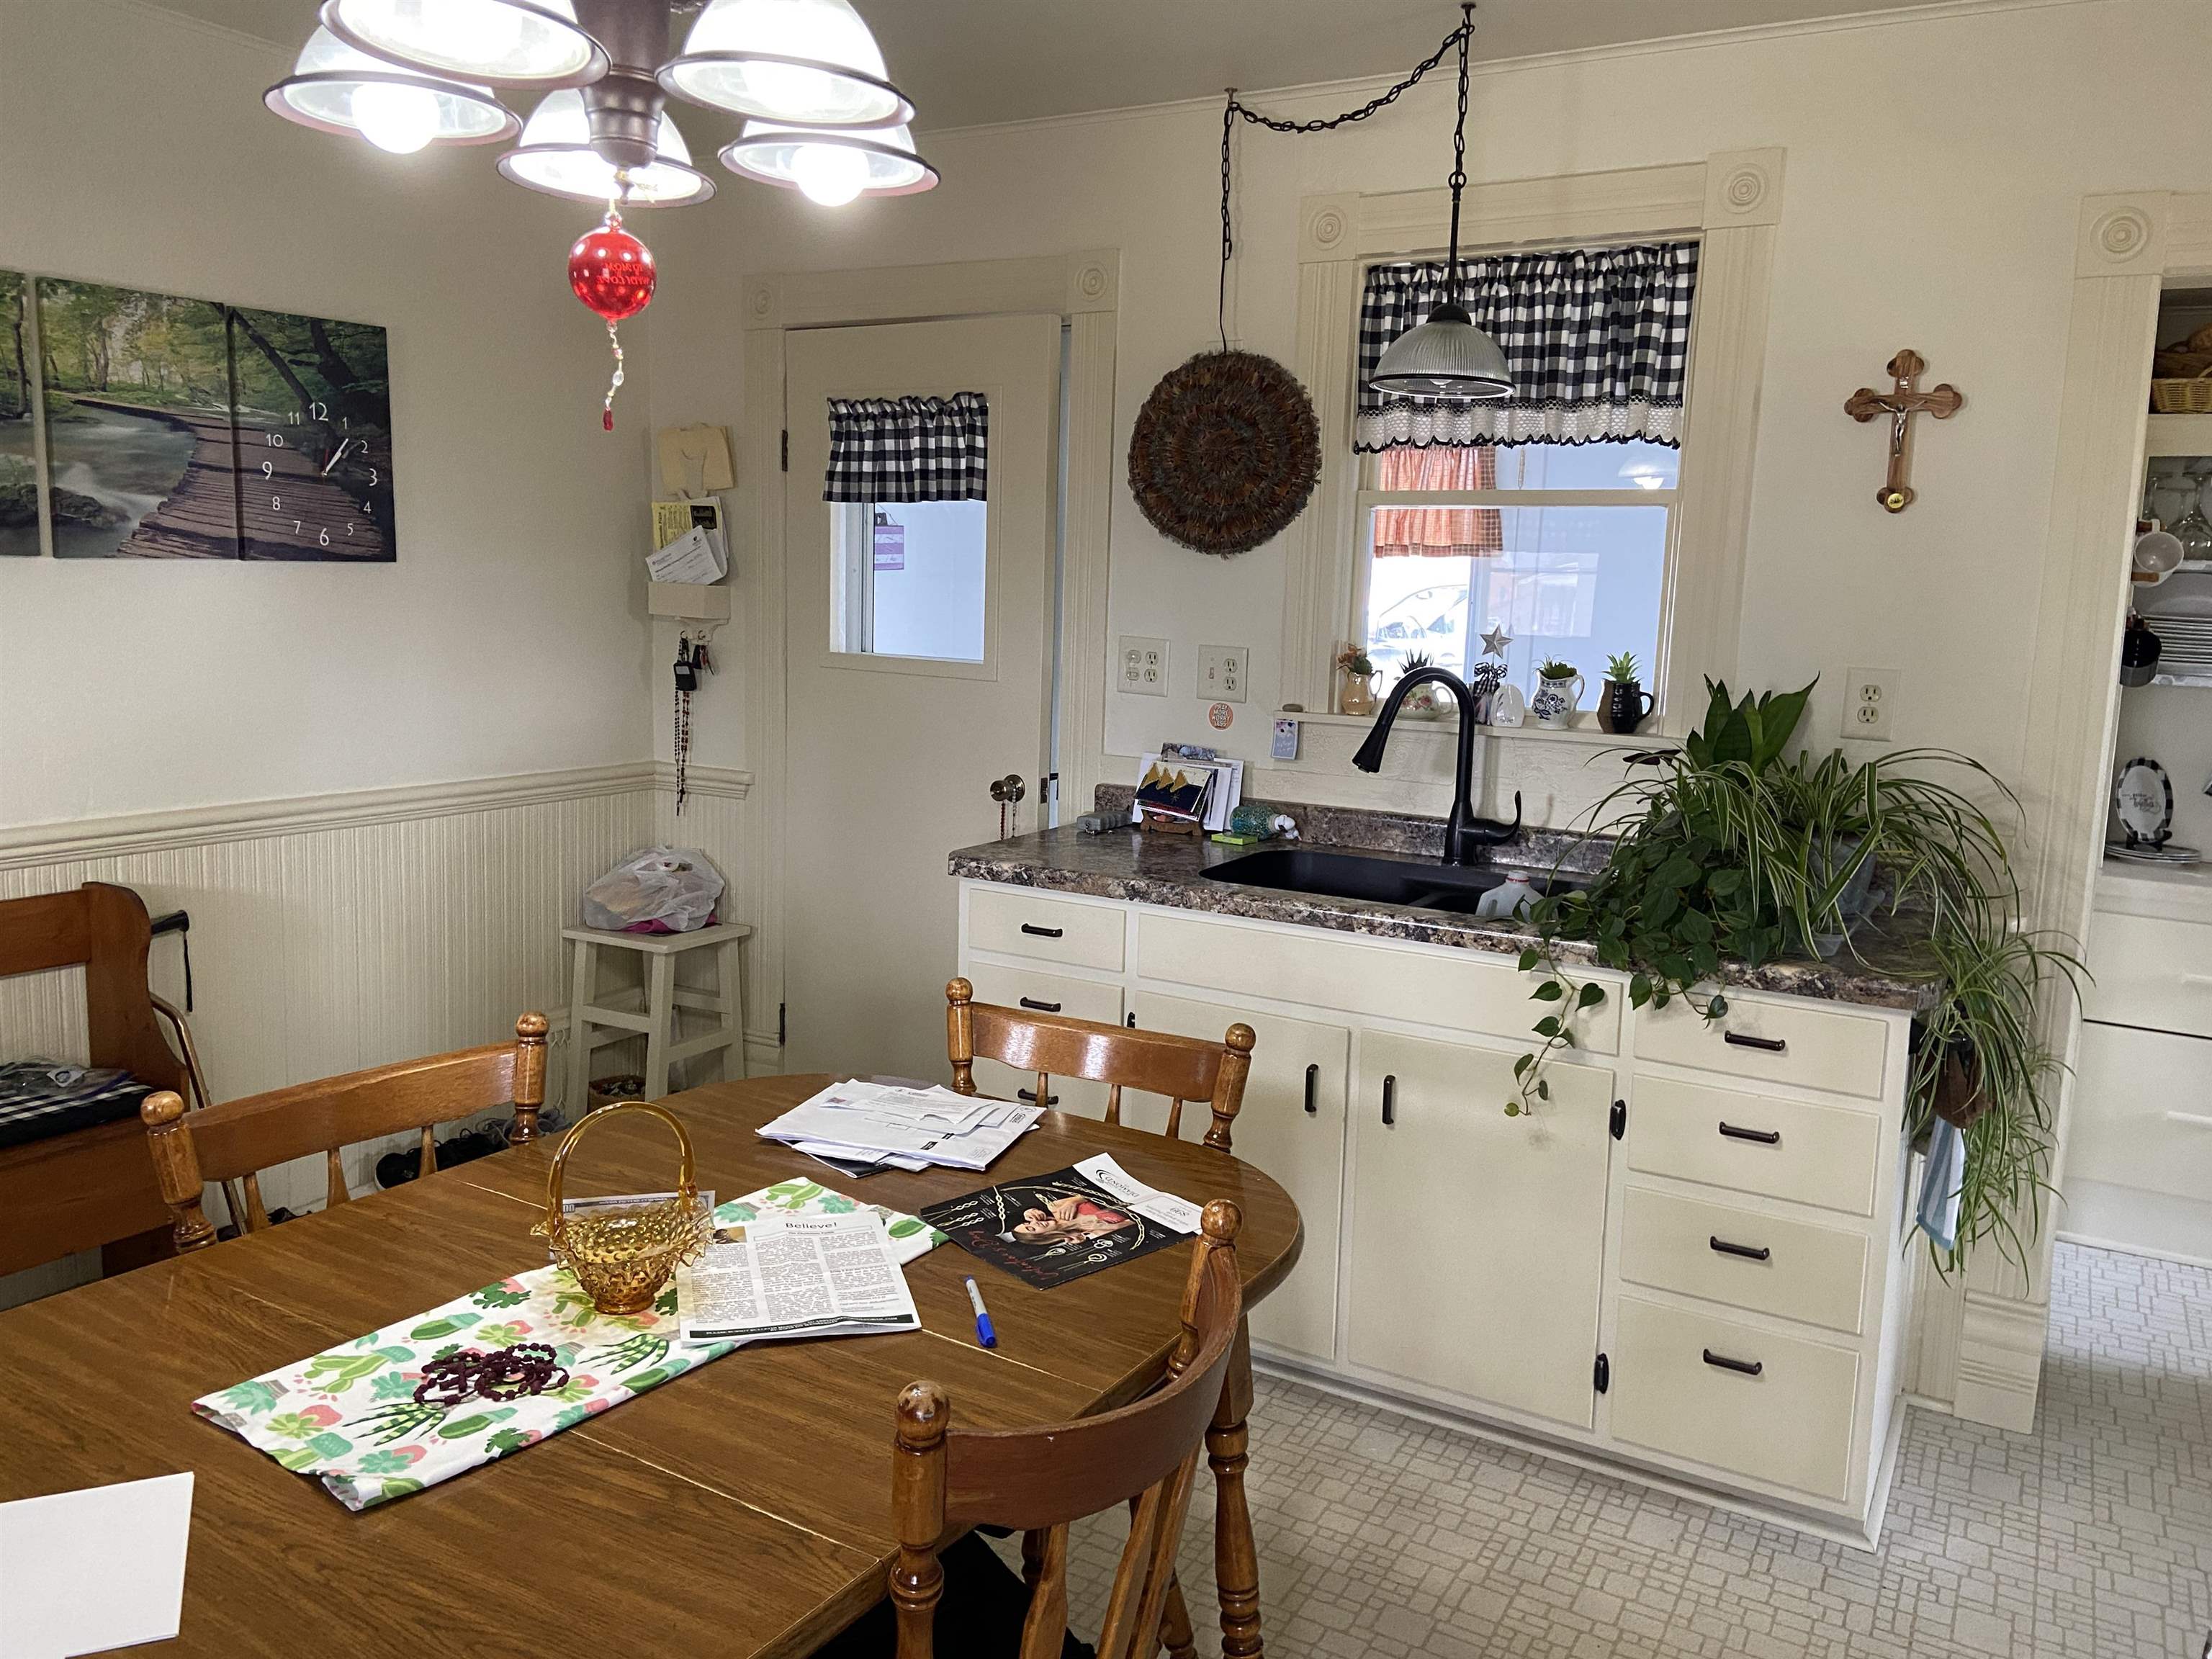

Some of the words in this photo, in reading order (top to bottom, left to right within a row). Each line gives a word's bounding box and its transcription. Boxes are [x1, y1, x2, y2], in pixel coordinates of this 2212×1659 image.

[309, 402, 328, 421] 12
[288, 412, 300, 426] 11
[342, 417, 348, 430] 1
[266, 433, 284, 447] 10
[360, 440, 369, 454] 2
[262, 462, 272, 480] 9
[369, 468, 377, 487] 3
[272, 496, 281, 511] 8
[363, 501, 372, 514] 4
[293, 521, 301, 534] 7
[347, 523, 354, 536] 5
[320, 528, 329, 546] 6
